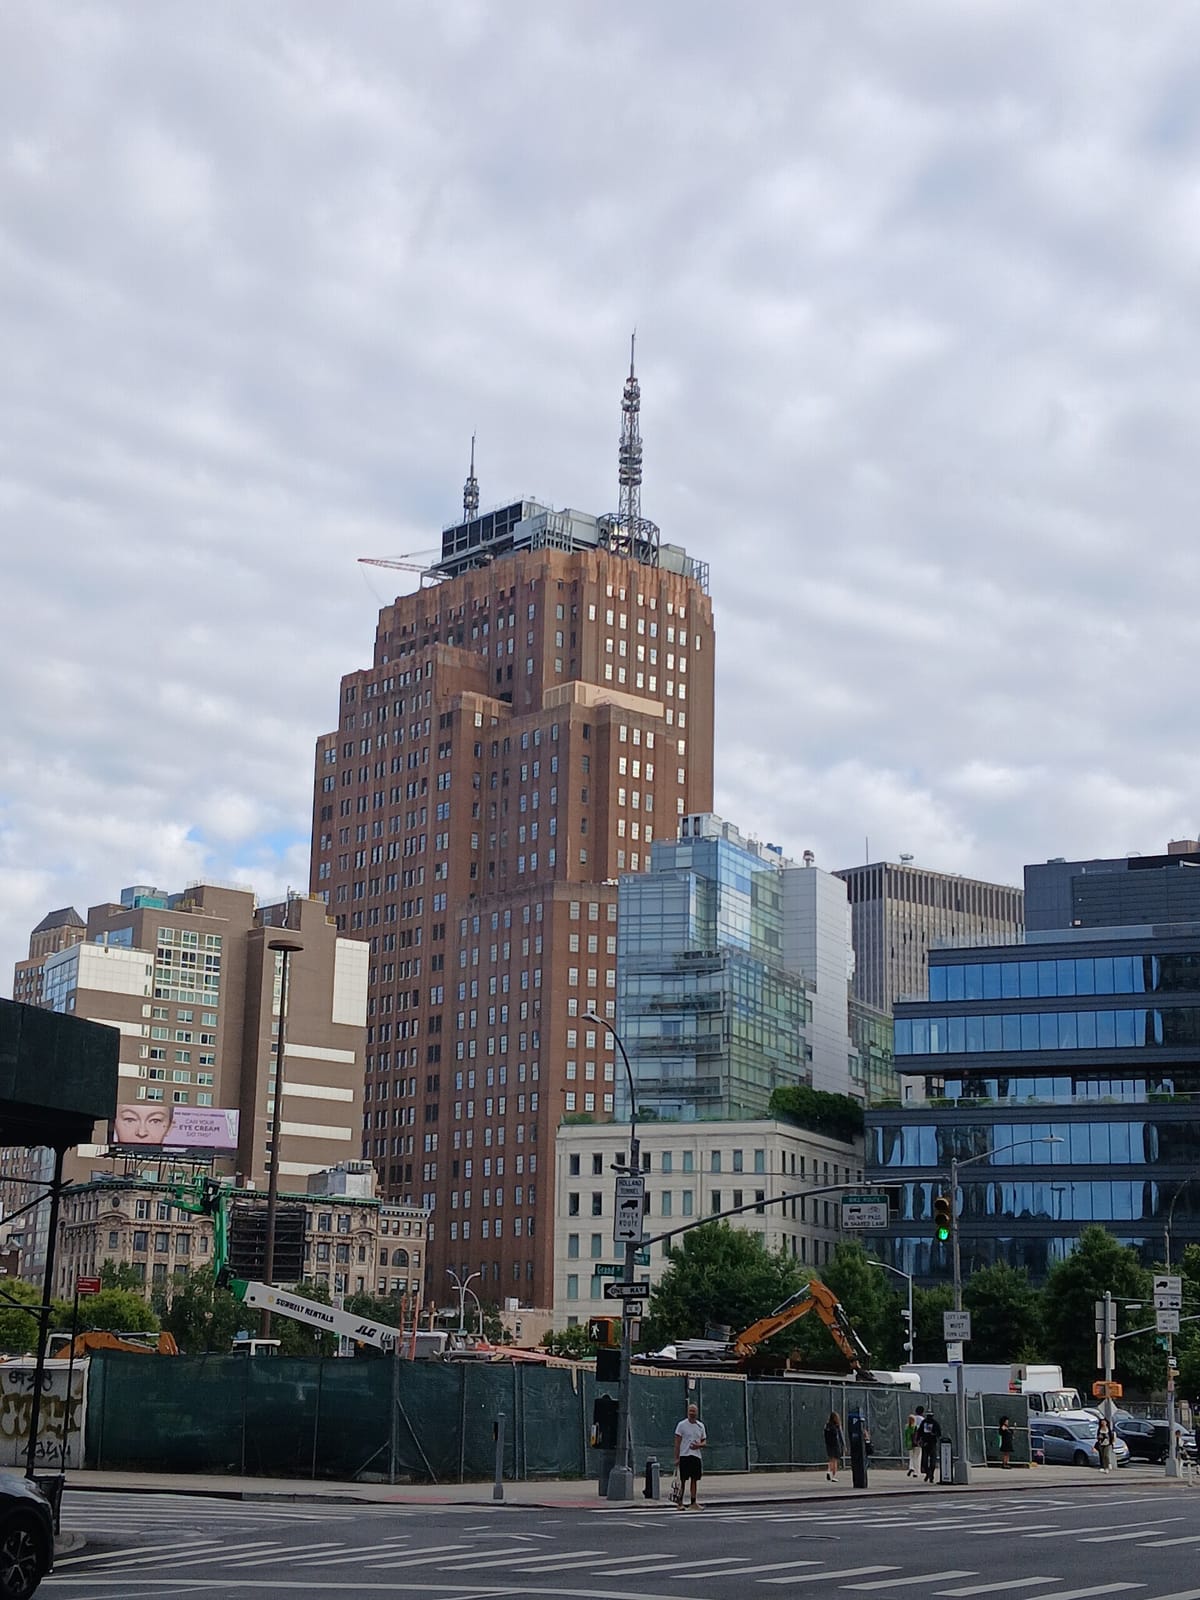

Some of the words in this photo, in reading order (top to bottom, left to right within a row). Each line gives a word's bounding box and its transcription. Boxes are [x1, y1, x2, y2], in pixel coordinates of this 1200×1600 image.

[597, 1265, 614, 1275] Grand
[304, 1307, 334, 1323] RENTALS
[355, 1325, 377, 1338] JLG
